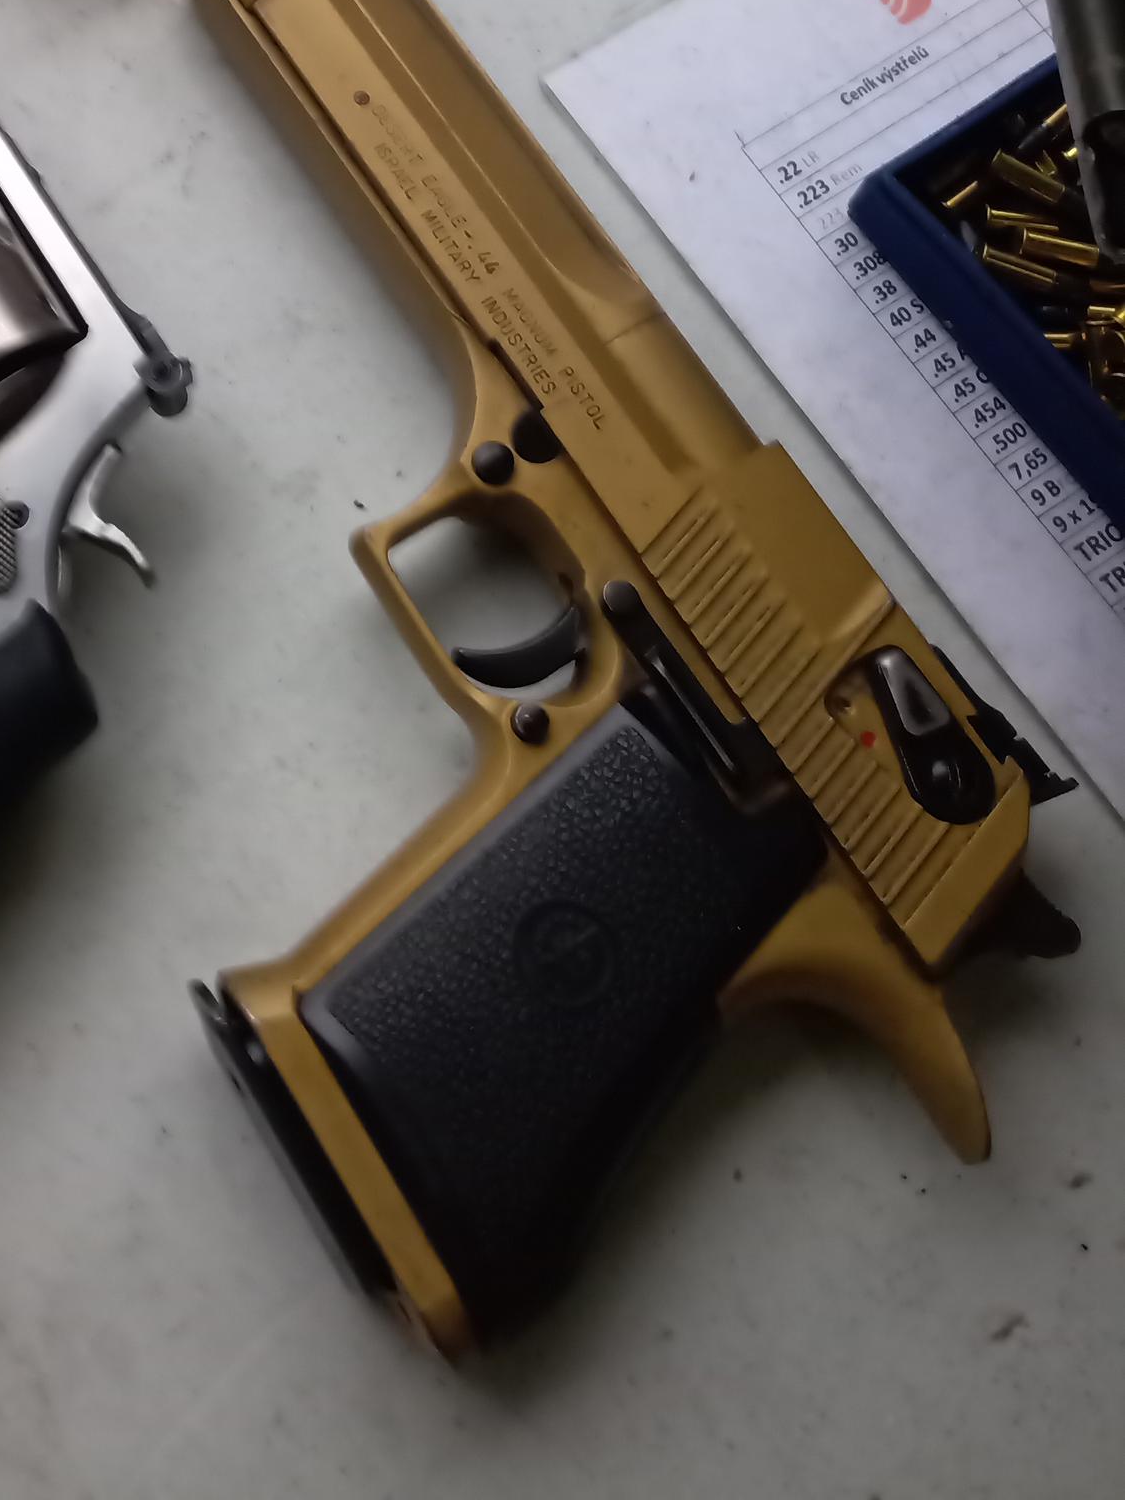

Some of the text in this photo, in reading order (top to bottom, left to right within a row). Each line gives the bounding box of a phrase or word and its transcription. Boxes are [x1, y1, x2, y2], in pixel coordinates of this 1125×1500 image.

[840, 46, 930, 106] Ceník výstřelů
[777, 160, 802, 184] .22
[797, 179, 830, 209] .223
[834, 231, 859, 256] .30
[420, 209, 481, 282] MILITARY
[481, 296, 557, 395] INDUSTRIES
[873, 279, 897, 304] .38
[890, 306, 912, 327] 40
[914, 328, 937, 353] .44
[933, 352, 956, 378] .45
[558, 366, 606, 430] PISTOL
[954, 377, 976, 403] .45
[974, 396, 1007, 428] .454
[992, 422, 1027, 454] .500
[1008, 447, 1048, 480] 7,65
[1030, 488, 1047, 506] 9
[1052, 515, 1068, 533] 9
[1073, 523, 1124, 562] TRIO
[1099, 561, 1125, 593] TR
